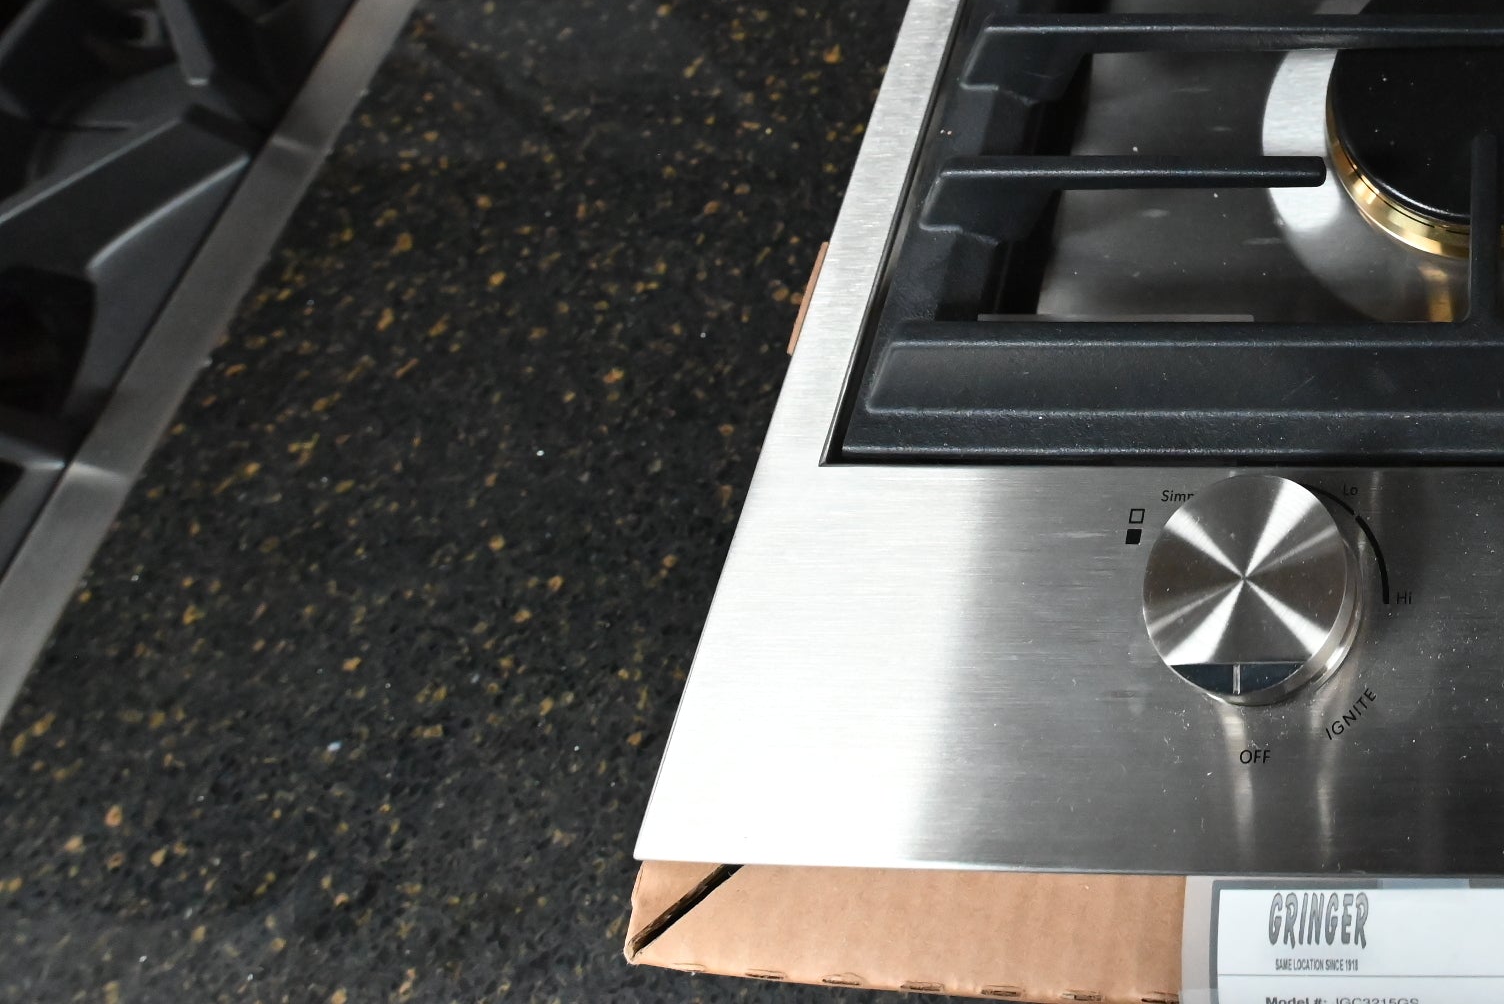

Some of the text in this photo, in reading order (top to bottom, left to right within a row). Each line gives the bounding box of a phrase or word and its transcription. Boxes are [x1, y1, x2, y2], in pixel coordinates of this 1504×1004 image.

[1342, 484, 1359, 496] Lo
[1396, 592, 1412, 605] Hi
[1325, 687, 1377, 741] IGNITE
[1239, 749, 1271, 765] OFF
[1267, 892, 1369, 949] GRINGER
[1275, 958, 1292, 971] SAME
[1293, 958, 1324, 971] LOCATION
[1325, 959, 1344, 972] SINCE
